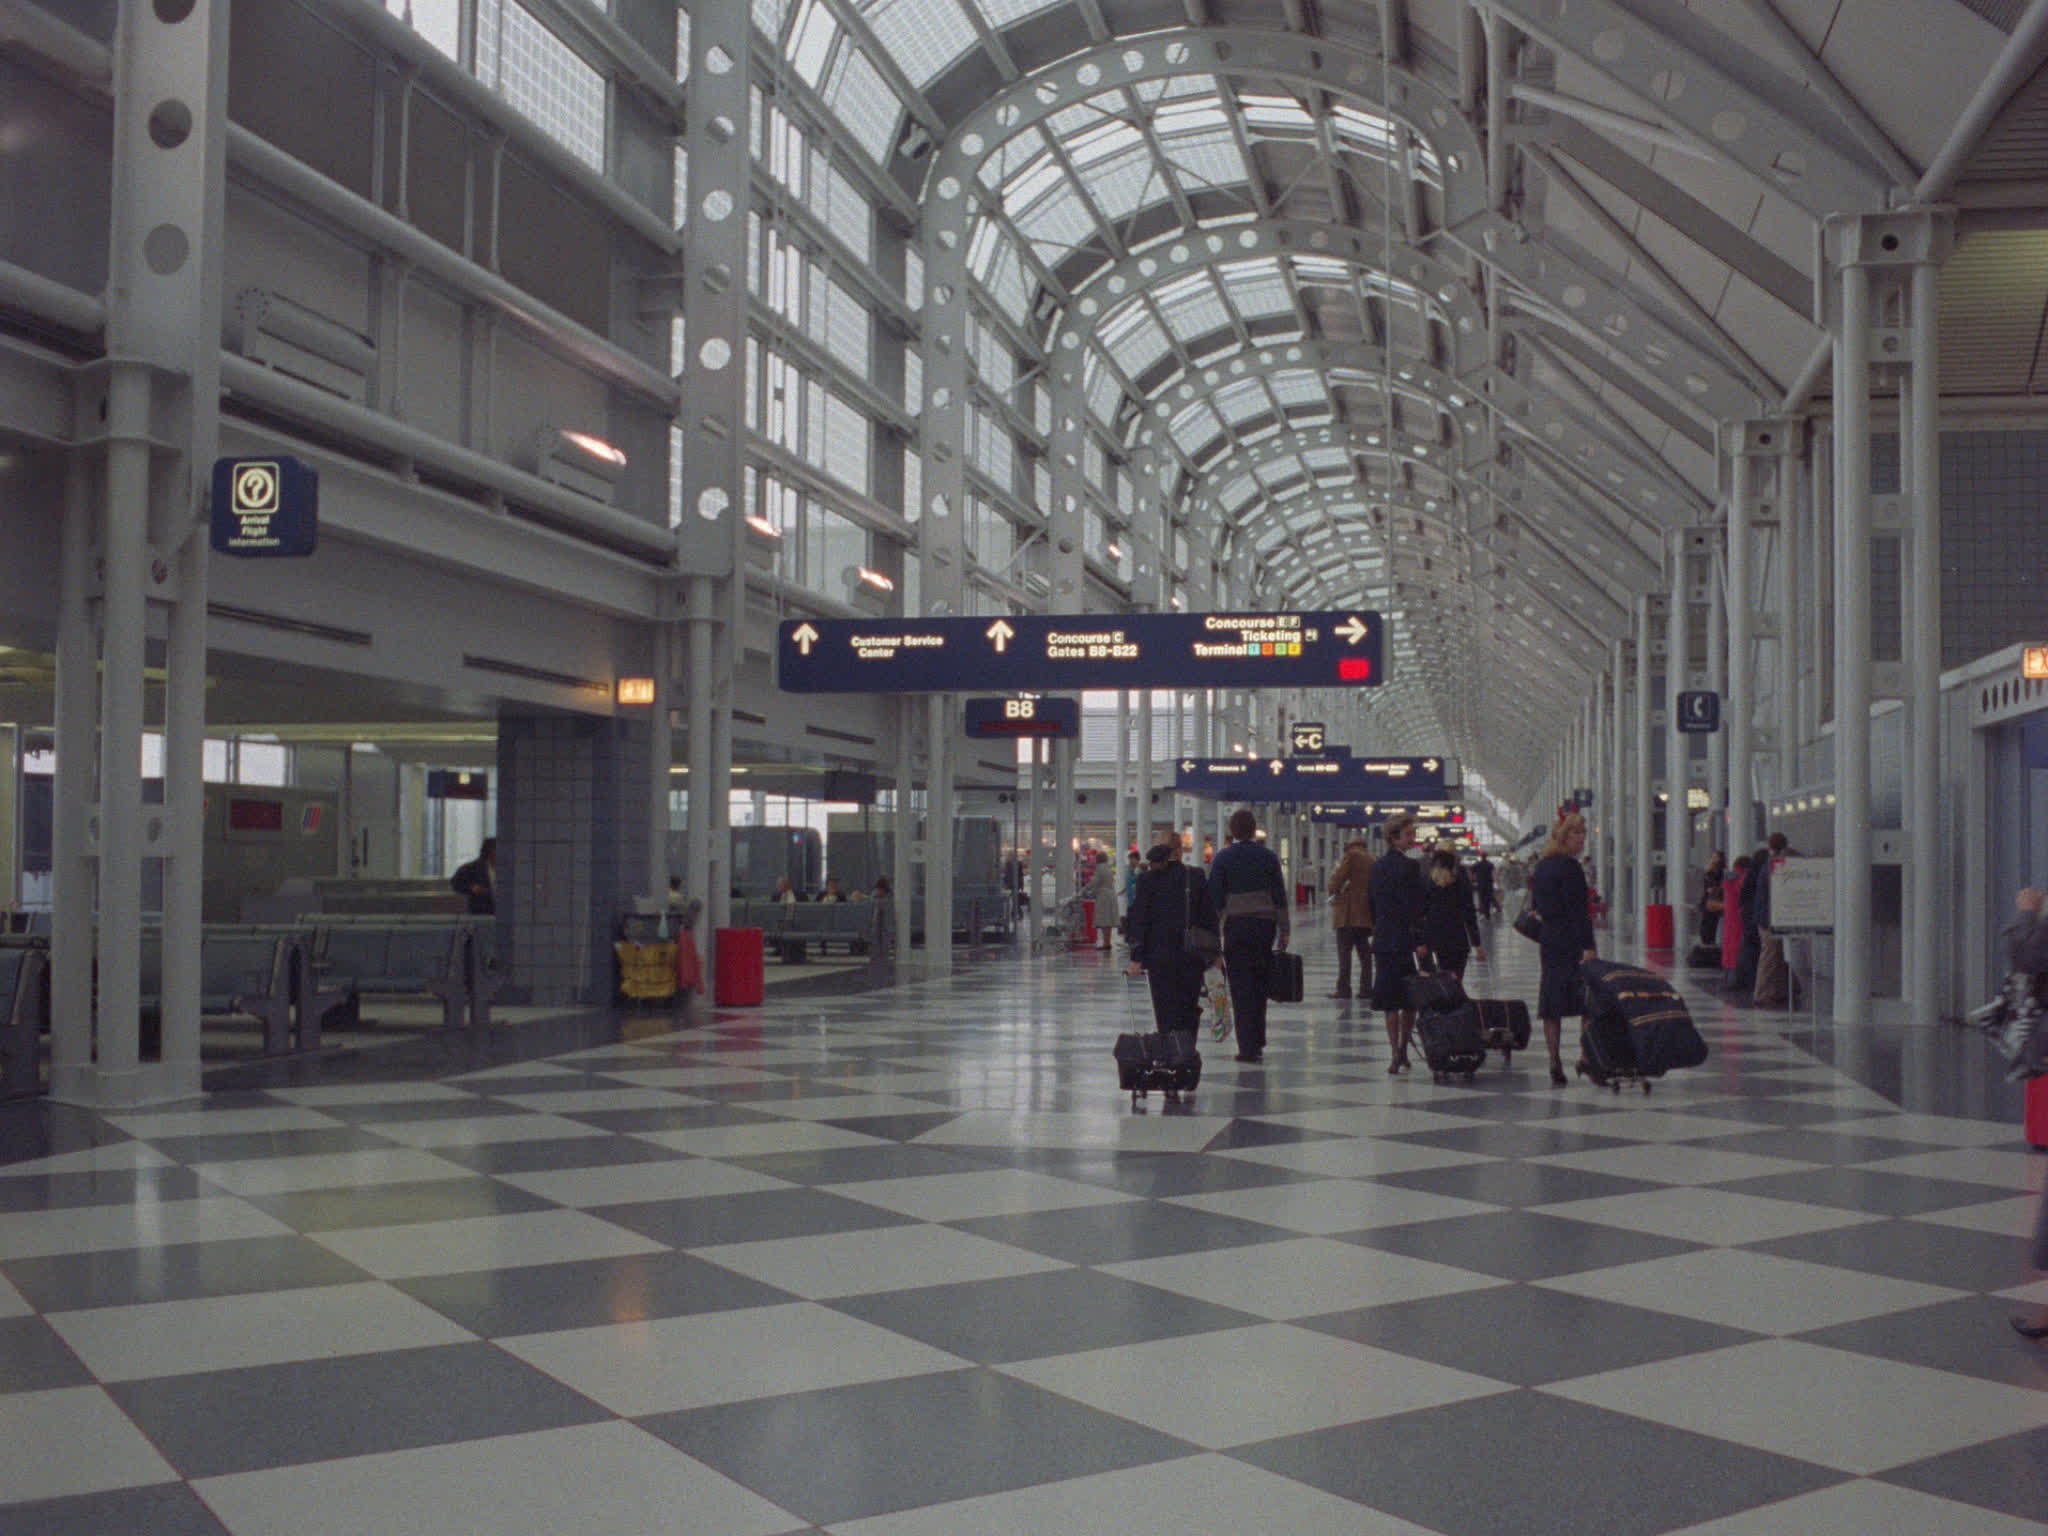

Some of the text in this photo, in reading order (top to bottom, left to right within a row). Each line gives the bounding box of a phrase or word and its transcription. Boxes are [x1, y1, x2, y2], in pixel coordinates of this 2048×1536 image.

[1206, 616, 1275, 629] Concourse
[852, 634, 944, 648] Customer Service
[1047, 632, 1111, 644] Concourse
[1241, 630, 1301, 643] Ticketing
[858, 648, 895, 658] Center
[1047, 645, 1086, 658] Gates
[1194, 643, 1248, 656] Terminal
[1005, 700, 1034, 718] B8
[1308, 734, 1322, 750] C
